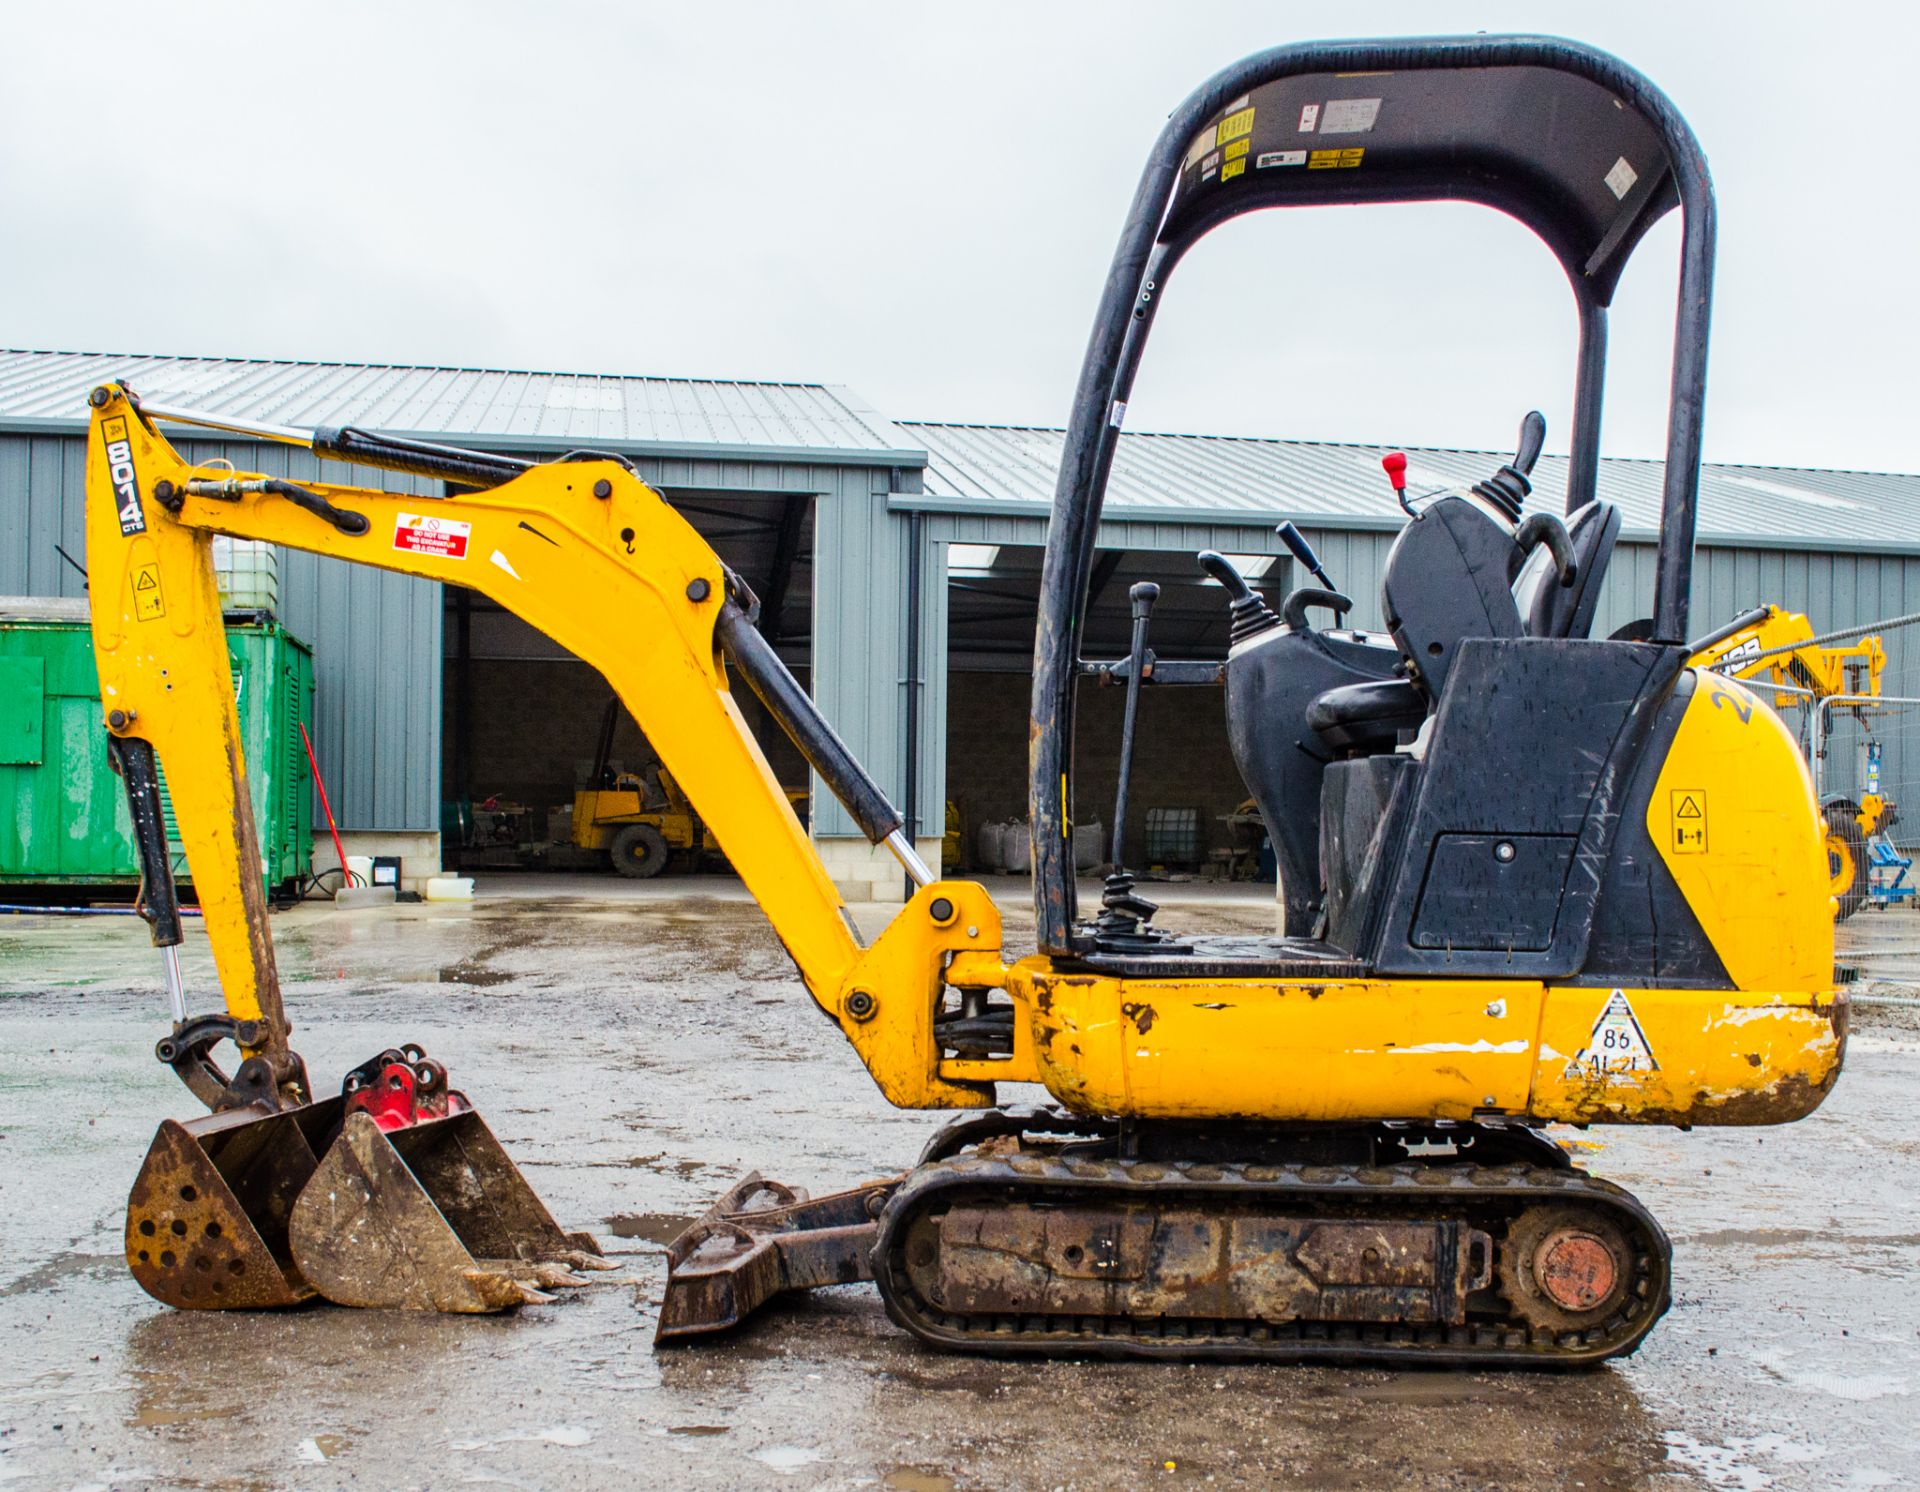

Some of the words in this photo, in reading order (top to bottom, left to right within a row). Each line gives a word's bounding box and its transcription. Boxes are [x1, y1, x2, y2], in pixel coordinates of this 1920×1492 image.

[107, 440, 143, 522] 8014
[406, 535, 420, 544] THIS
[424, 531, 437, 539] NOT
[437, 533, 450, 541] USE
[426, 546, 448, 554] CRANE
[1719, 637, 1760, 677] JCB
[1603, 1028, 1630, 1050] 86
